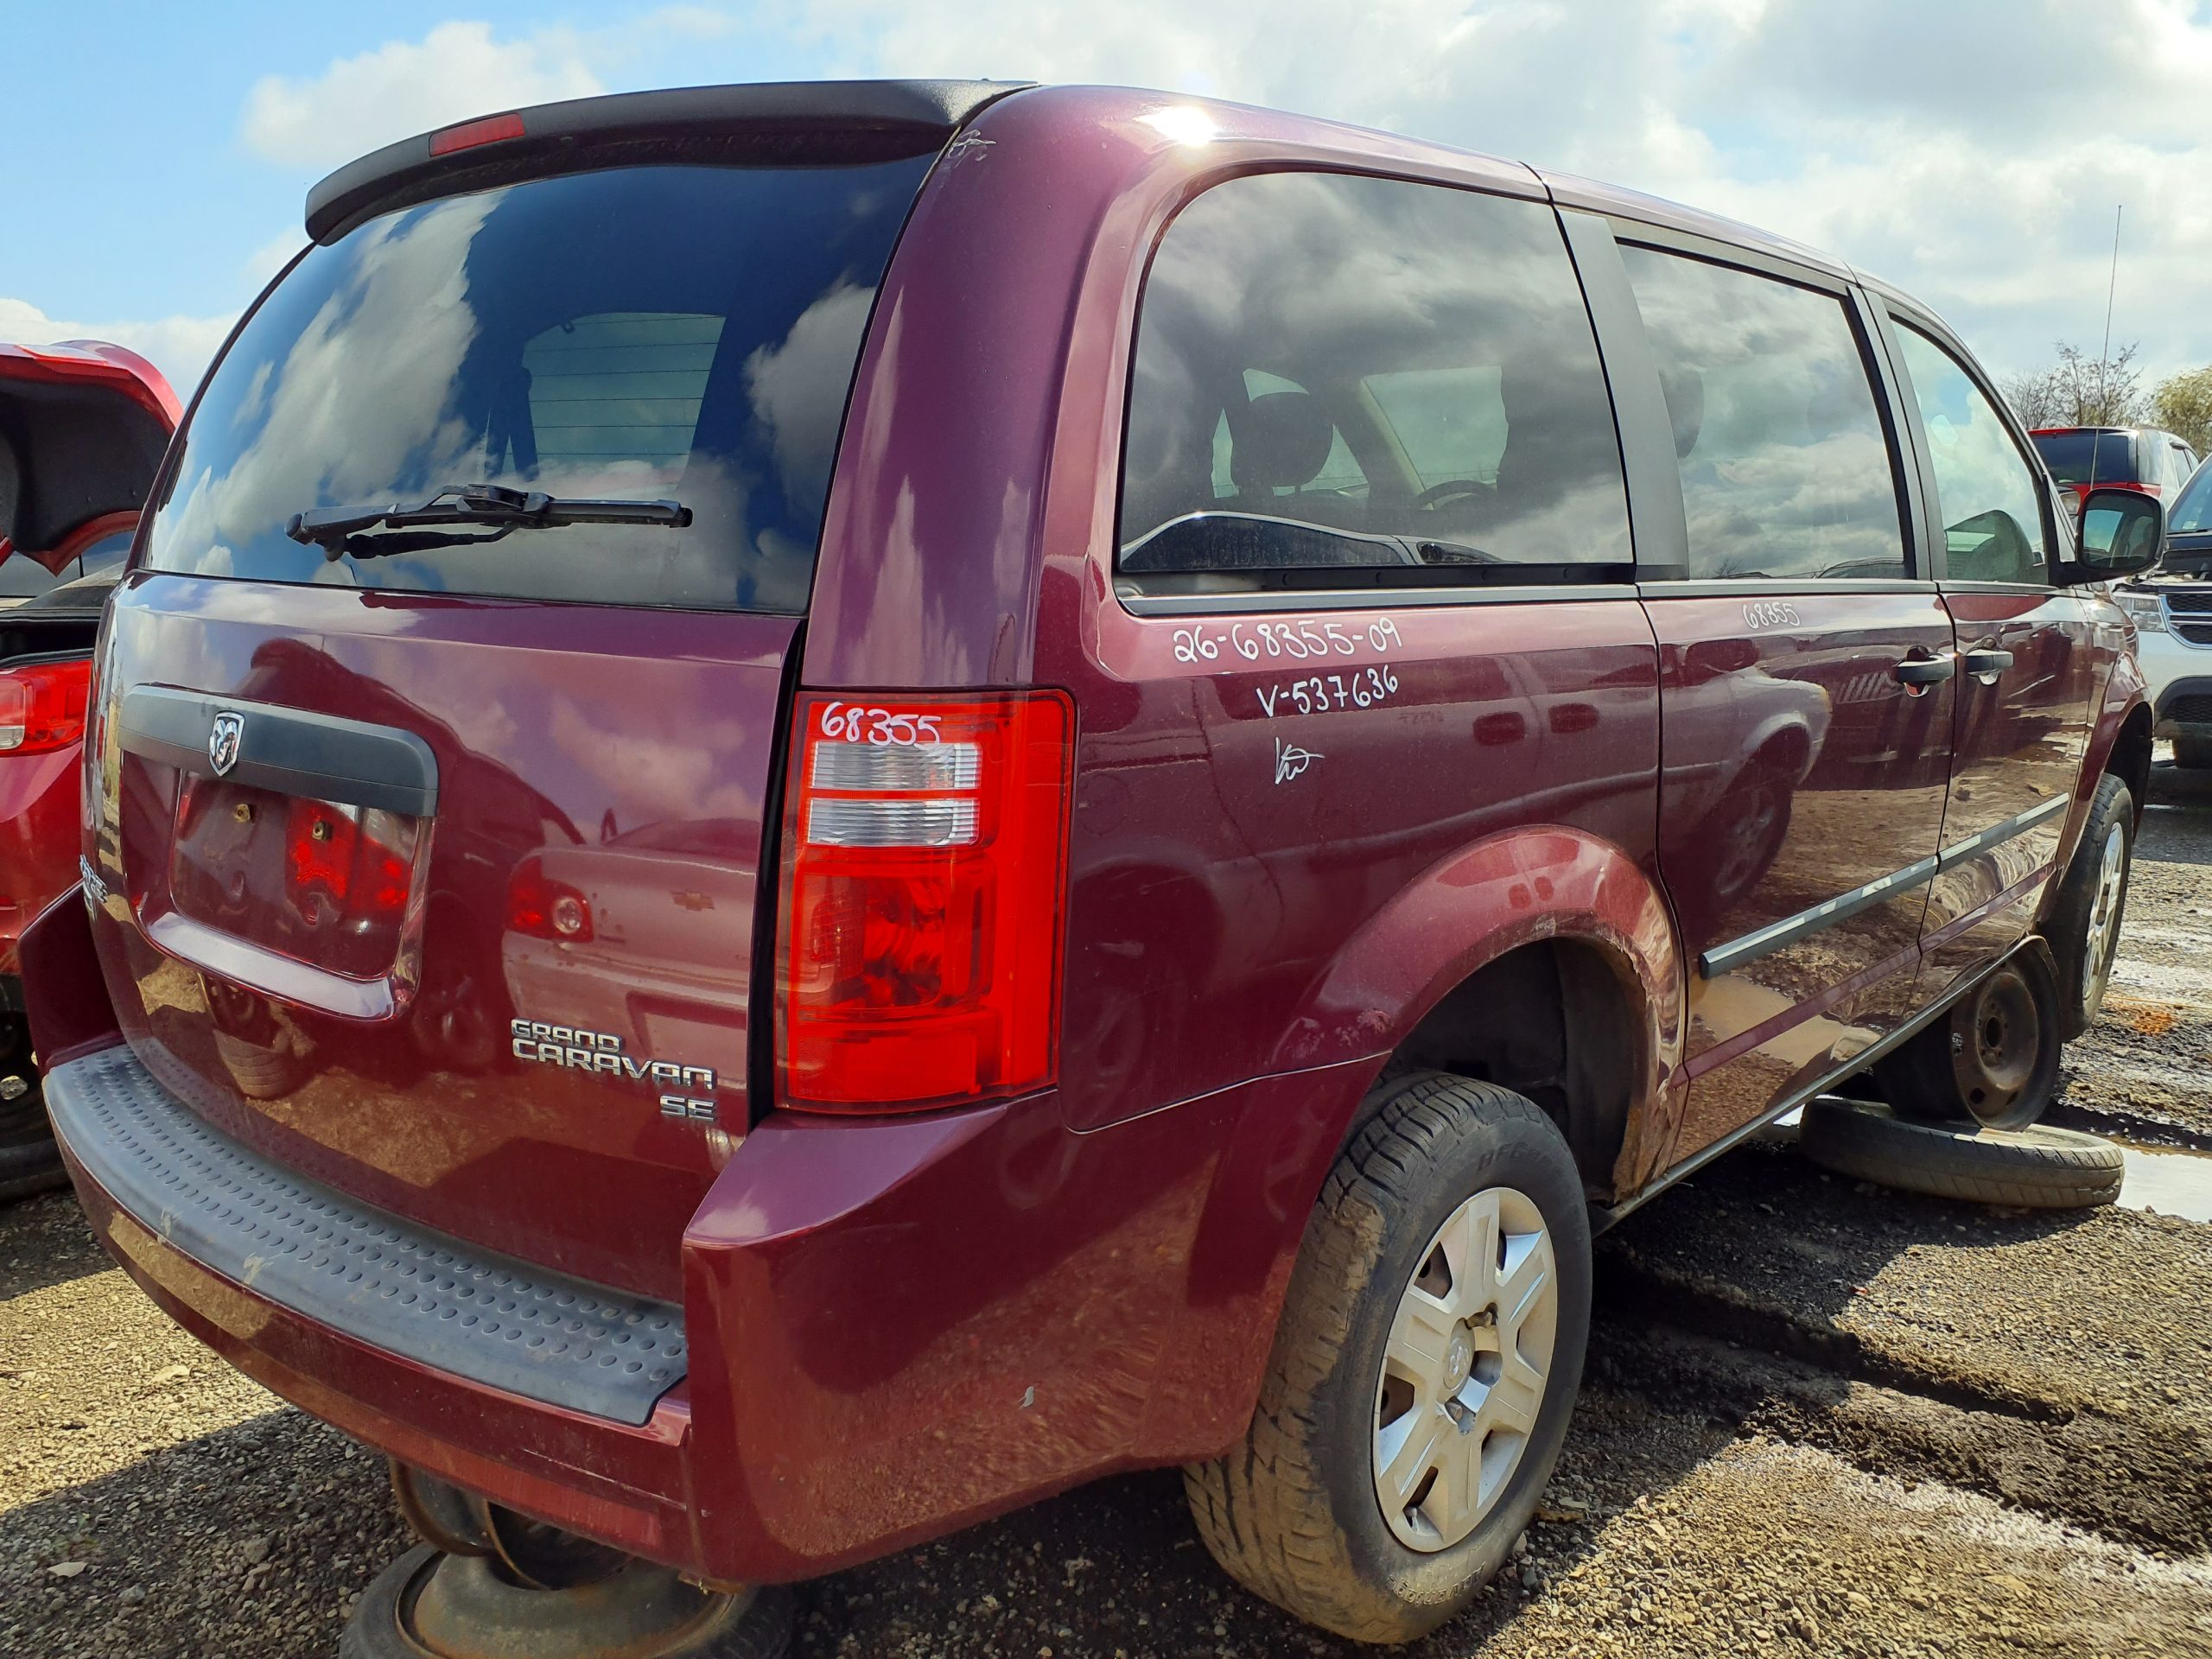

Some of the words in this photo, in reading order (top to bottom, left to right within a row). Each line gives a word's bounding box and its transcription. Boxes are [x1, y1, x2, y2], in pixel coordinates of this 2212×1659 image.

[1743, 601, 1801, 629] 68355
[1173, 616, 1402, 663] 26-68355-09
[1256, 664, 1398, 718] V-537636
[822, 702, 942, 750] 68355
[511, 1018, 622, 1053] GRAND
[512, 1038, 717, 1090] CARAVAN
[659, 1094, 717, 1122] SE
